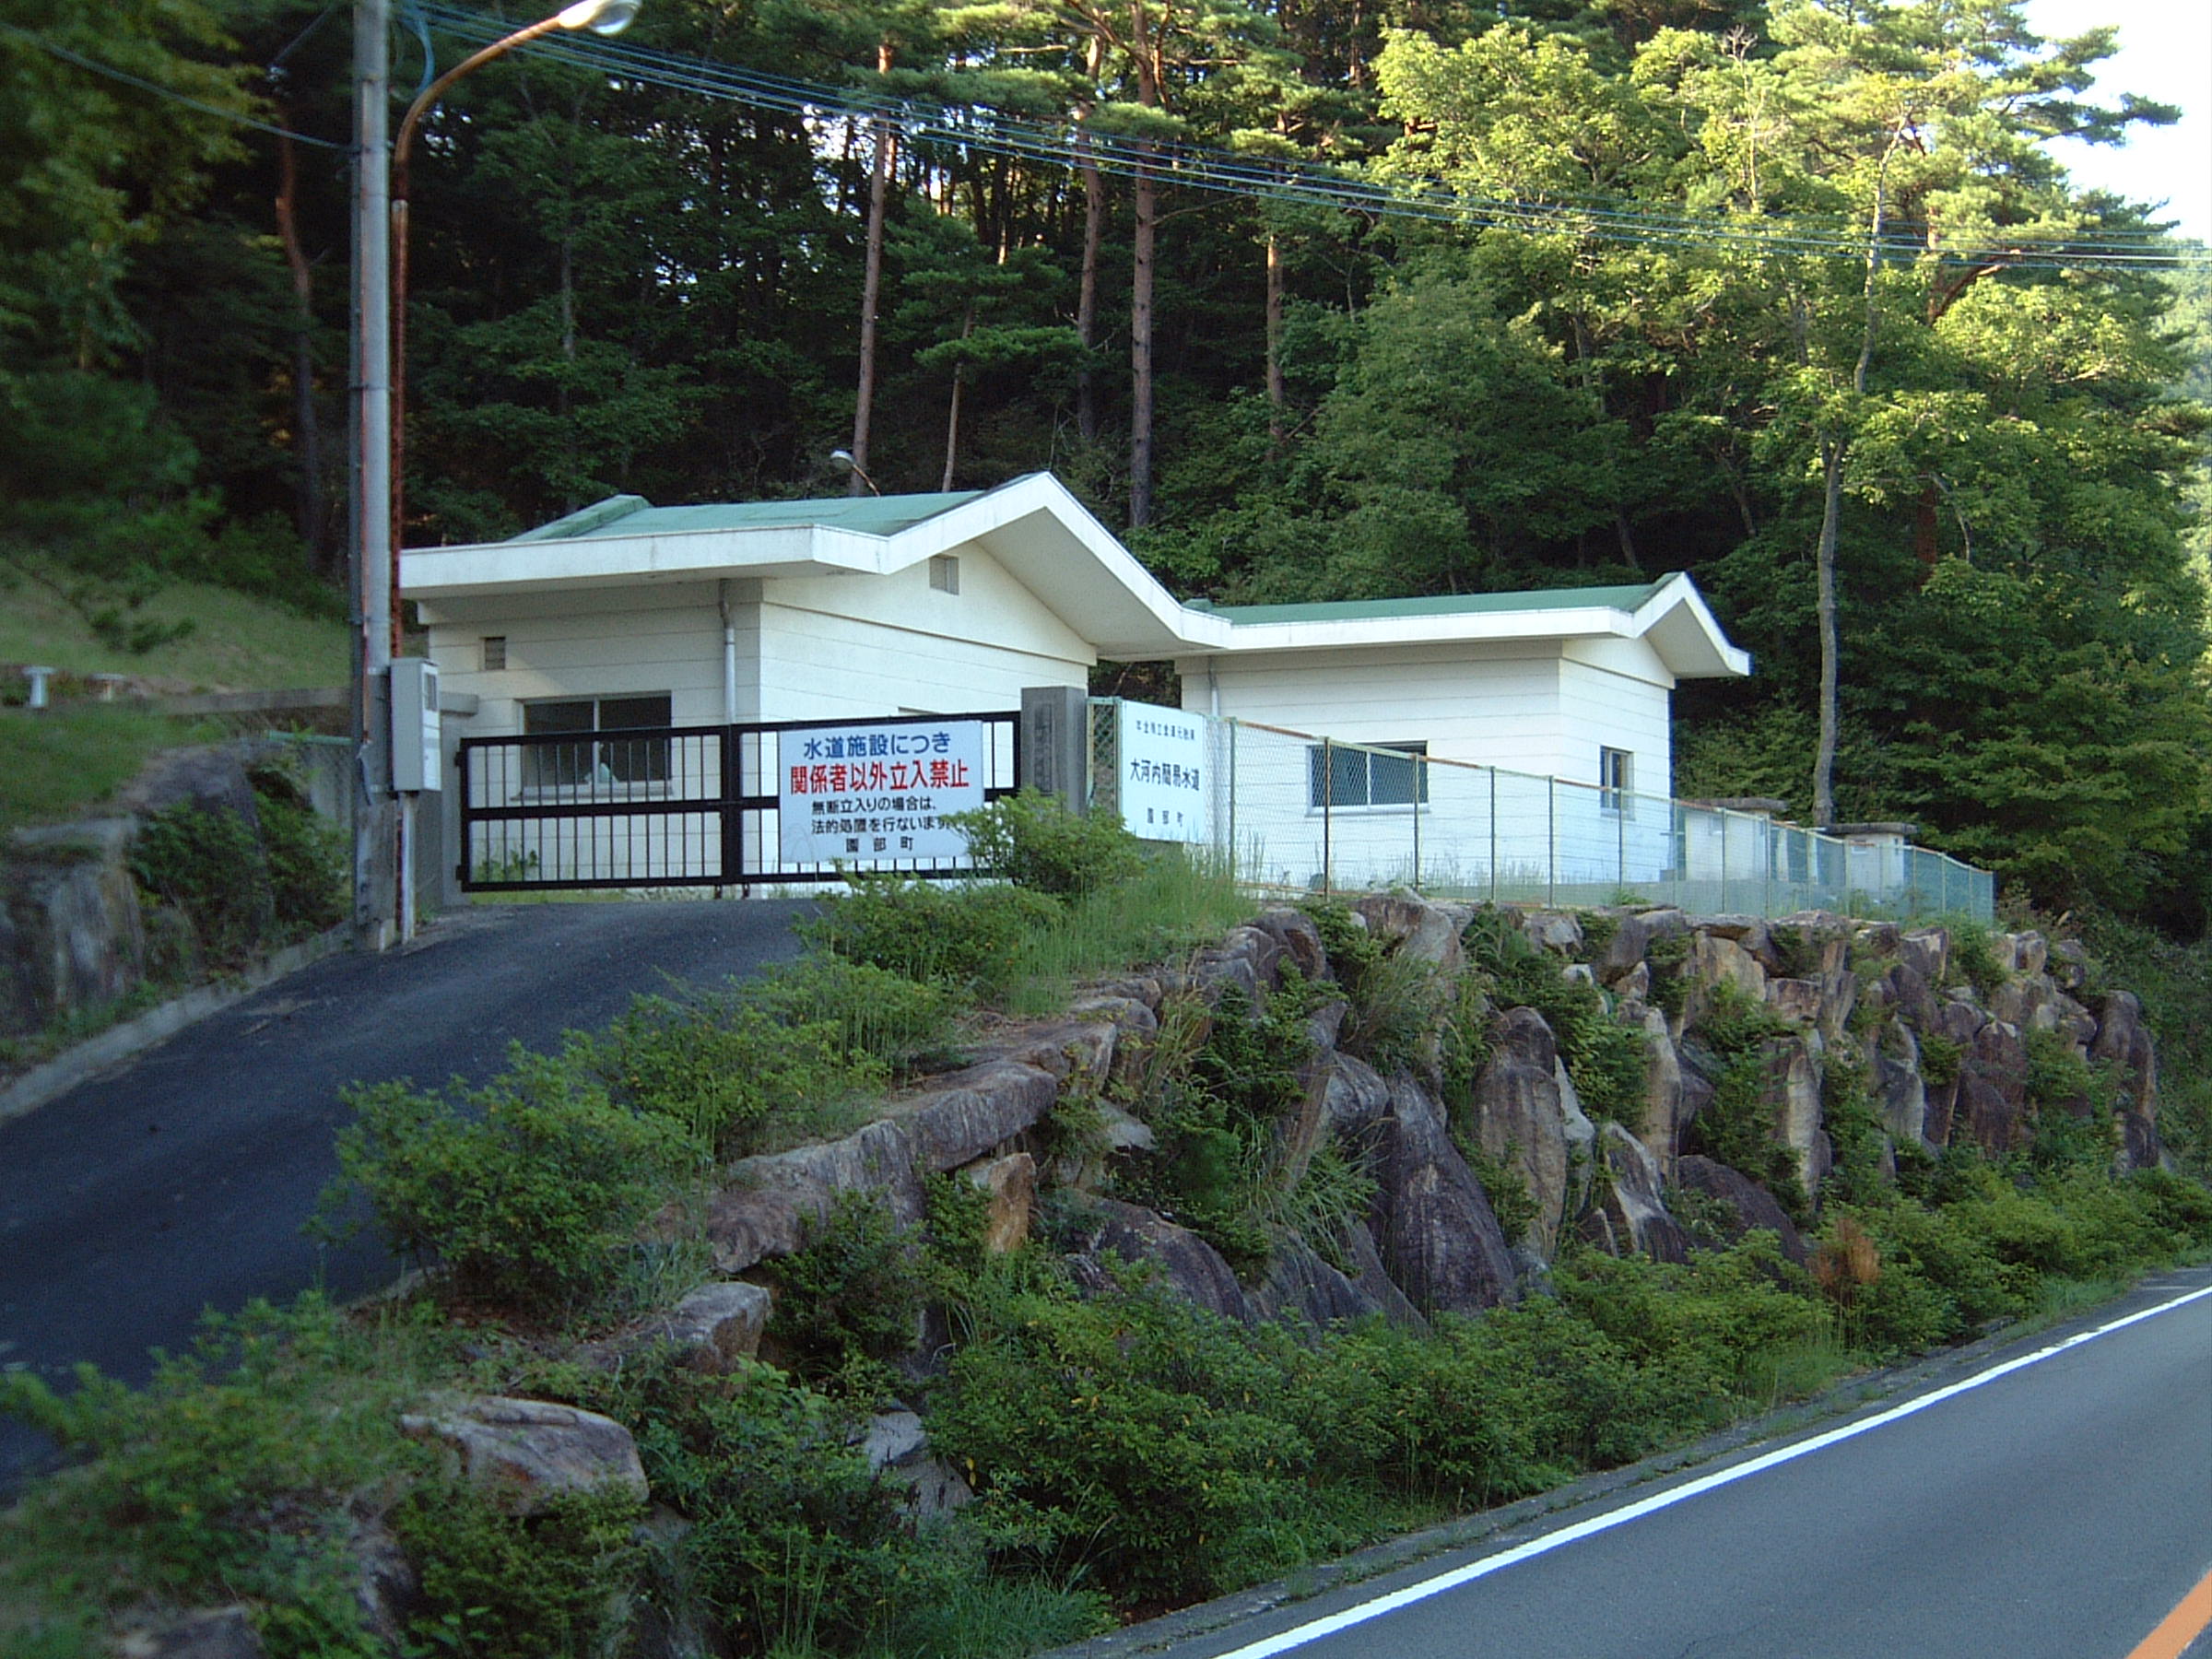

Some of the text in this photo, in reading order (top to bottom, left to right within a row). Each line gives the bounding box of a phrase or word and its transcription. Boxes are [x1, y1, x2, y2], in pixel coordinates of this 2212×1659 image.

[803, 731, 951, 760] 水道施設につき
[790, 759, 970, 795] 関係者以外立入禁止
